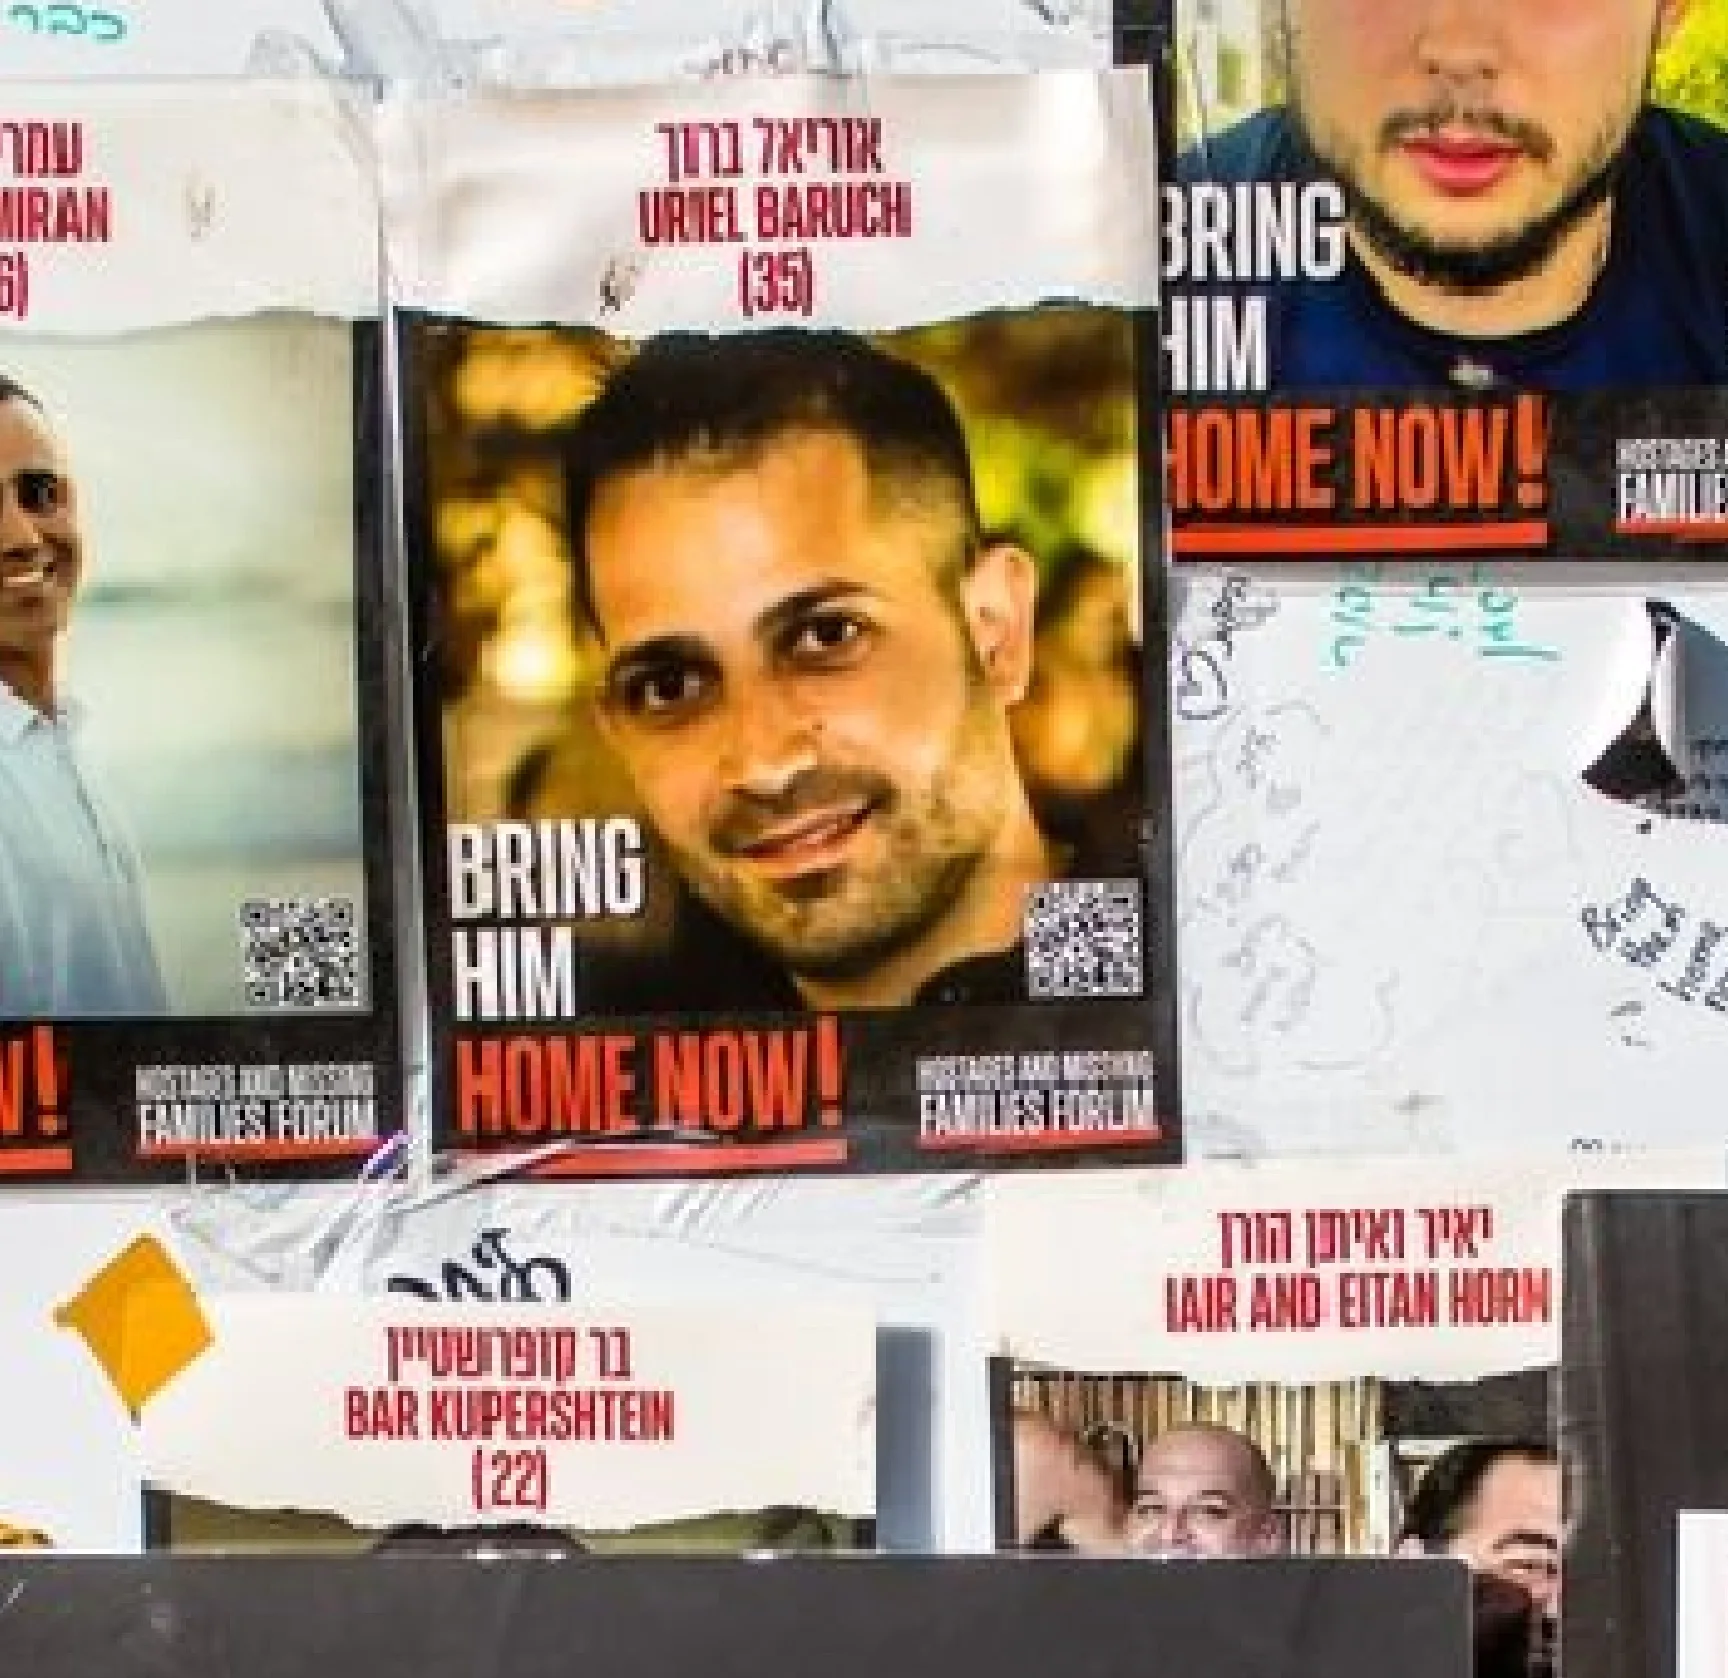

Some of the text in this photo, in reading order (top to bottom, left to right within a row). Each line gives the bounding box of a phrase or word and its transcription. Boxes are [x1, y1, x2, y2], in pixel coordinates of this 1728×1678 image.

[0, 122, 82, 178] עמר
[654, 117, 885, 182] אוריאל ברוך
[639, 182, 912, 247] URIEL BARUCH
[742, 247, 812, 319] (35)
[1351, 394, 1547, 509] NOW!
[447, 818, 646, 918] BRING
[452, 927, 576, 1021] HIM
[456, 1015, 843, 1131] HOME NOW!
[140, 1099, 378, 1149] FAMILIES FORUM
[920, 1089, 1153, 1140] FAMILIES FORUM
[1217, 1204, 1493, 1268] יאיר ואיתן הורן
[1166, 1267, 1553, 1332] IAIR AND EITAN HORN
[383, 1326, 632, 1385] בר קופרשטיין
[345, 1386, 674, 1440] BAR KUPERSHTEIN
[472, 1446, 548, 1511] (22)
